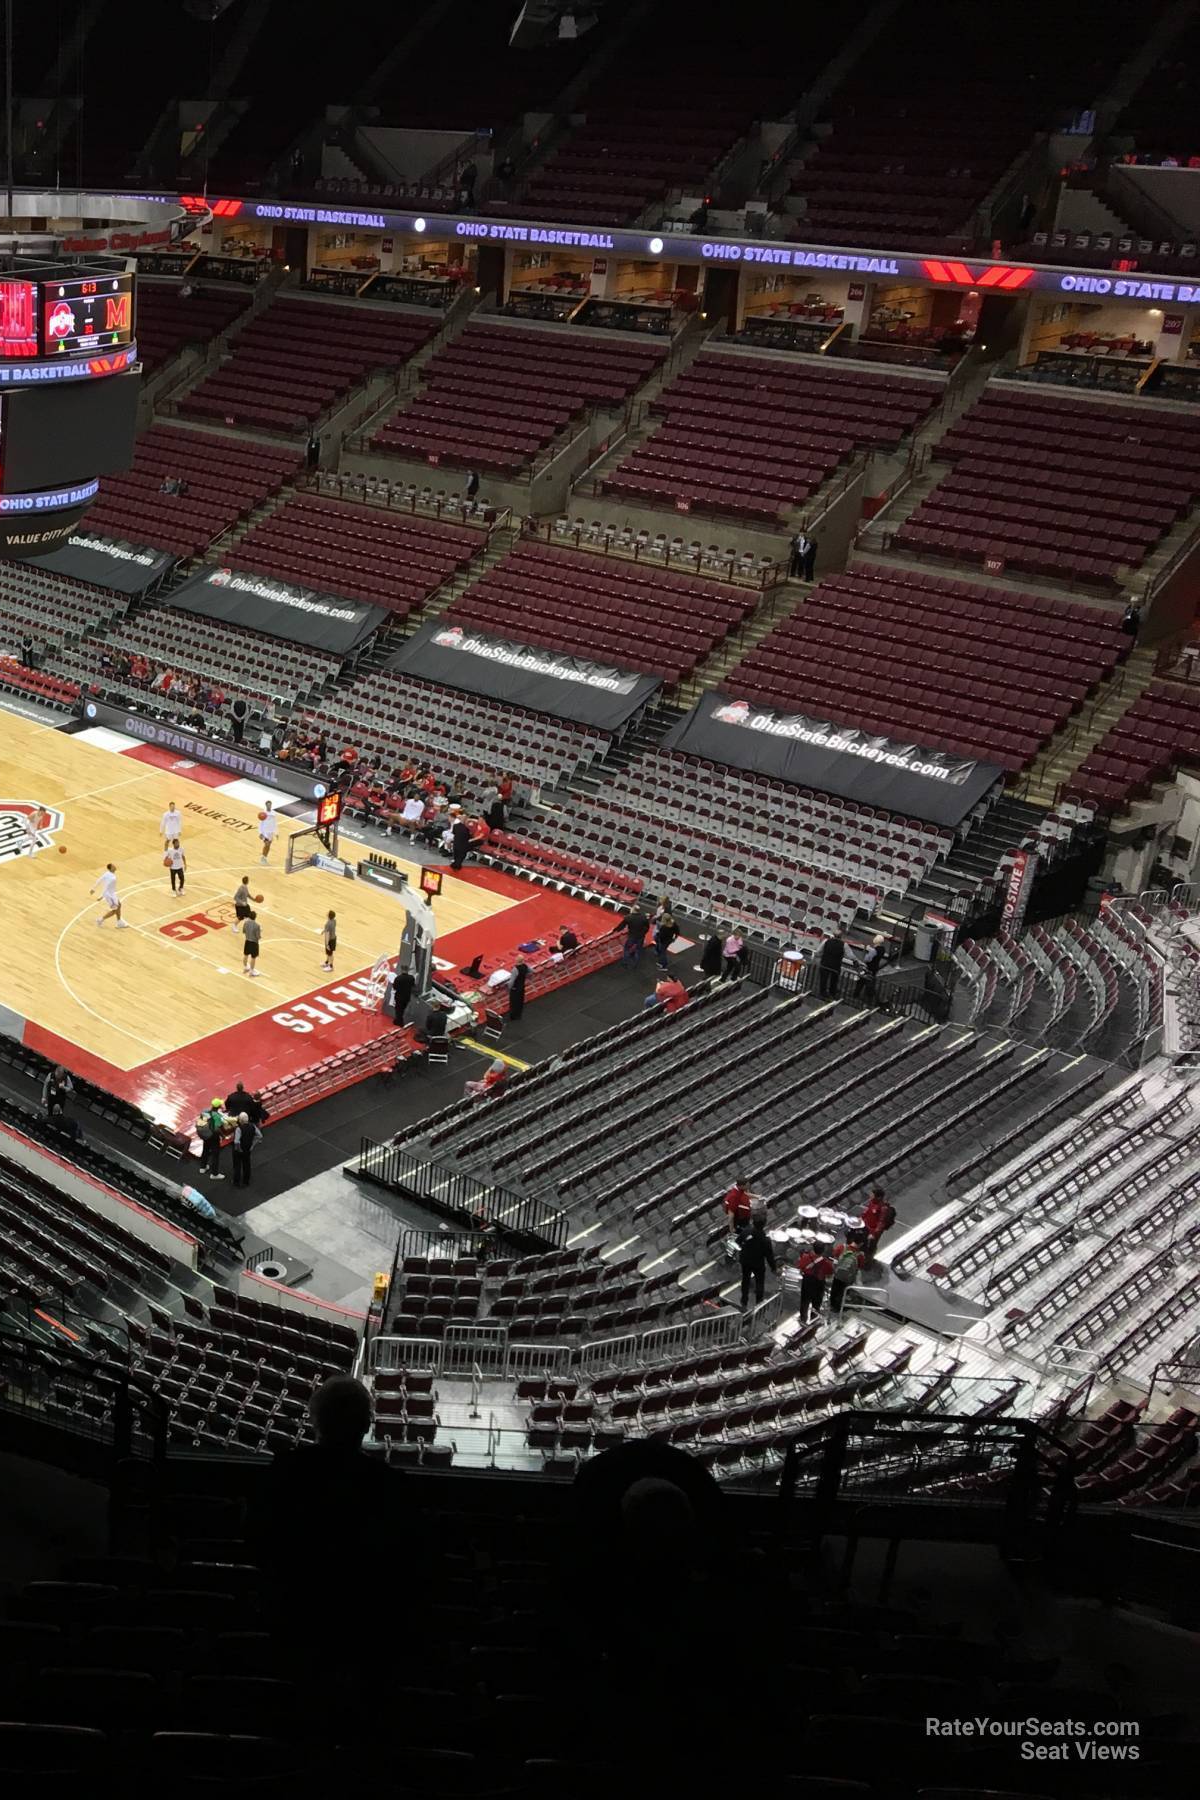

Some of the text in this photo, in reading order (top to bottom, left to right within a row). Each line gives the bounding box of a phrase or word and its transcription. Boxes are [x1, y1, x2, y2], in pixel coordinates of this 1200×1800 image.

[256, 205, 386, 228] OHIO STATE BASKETBALL
[456, 222, 614, 249] OHIO STATE BASKETBALL
[701, 243, 899, 275] OHIO STATE BASKETBALL
[1060, 274, 1112, 294] OHIO
[1114, 280, 1175, 301] STATE
[13, 363, 90, 380] BASKETBALL
[0, 497, 33, 510] OHIO
[36, 493, 69, 507] STATE
[6, 533, 39, 545] VALUE
[42, 528, 63, 542] CITY
[987, 559, 1002, 569] 107
[229, 577, 356, 621] OhioStateBuckeyes.com
[462, 638, 620, 692] OhioStateBuckeyes.com
[125, 718, 278, 783] OHIO STATE BASKETBALL
[750, 713, 950, 781] OhioStateBuckeyes.com
[184, 802, 224, 820] VALUE
[222, 816, 258, 831] CITY
[323, 803, 337, 822] 30
[1006, 867, 1023, 904] STATE
